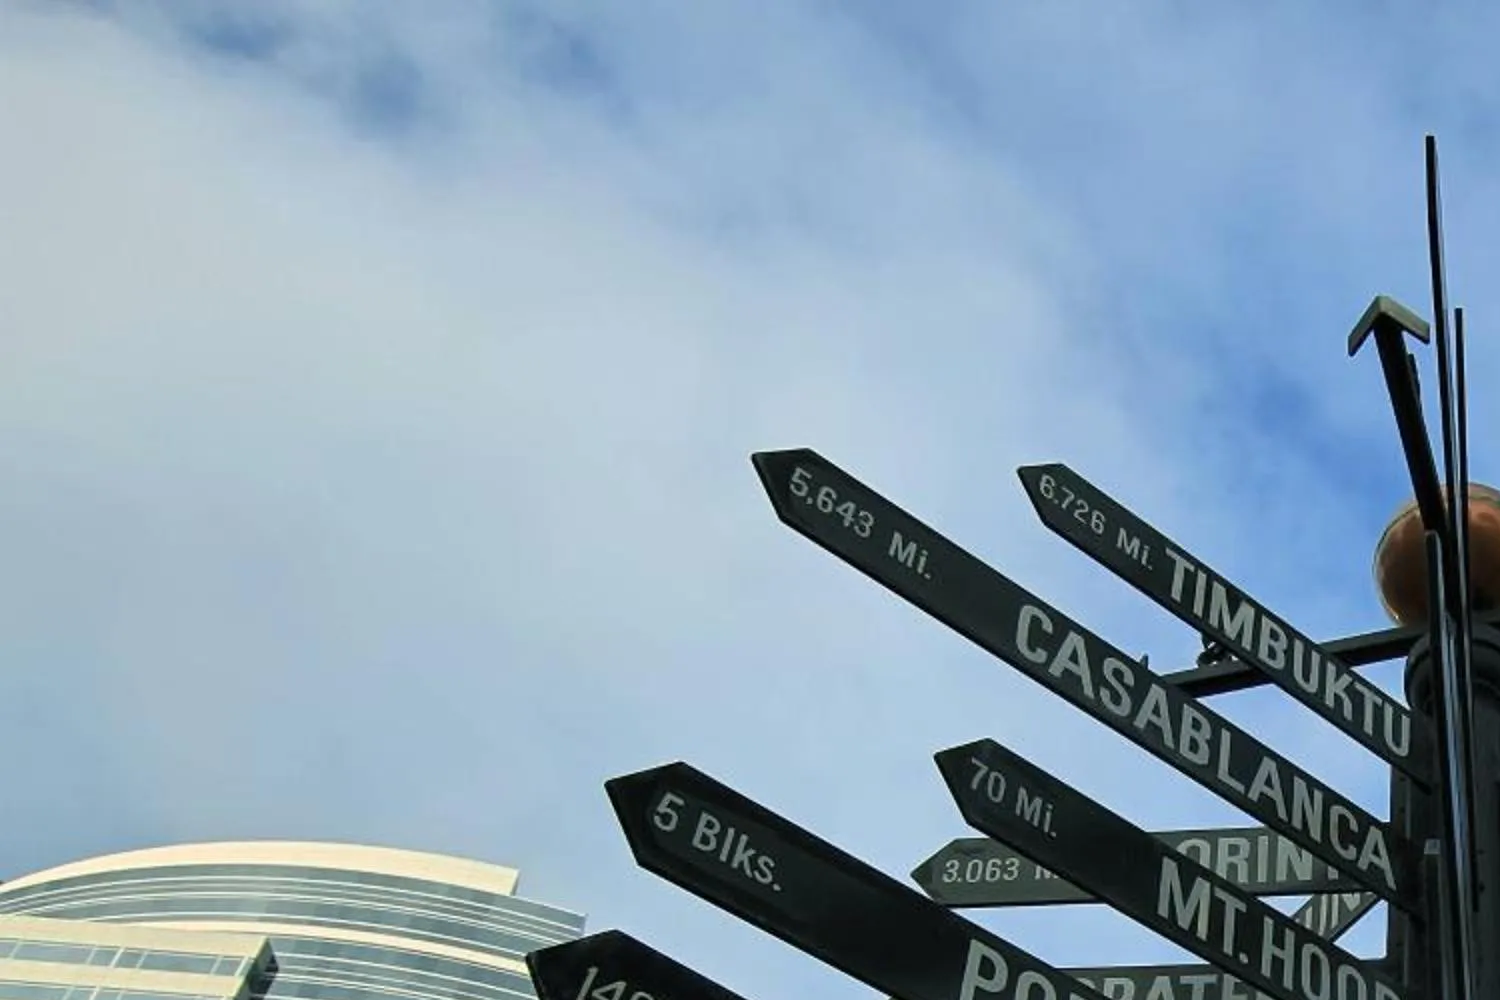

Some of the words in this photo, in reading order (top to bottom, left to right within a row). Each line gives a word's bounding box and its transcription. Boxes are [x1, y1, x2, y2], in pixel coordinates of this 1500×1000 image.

[888, 531, 931, 580] Mi.
[1015, 605, 1396, 891] CASABLANCA
[1116, 527, 1153, 571] Mi.
[1165, 548, 1411, 757] TIMBUKTU
[653, 792, 685, 832] 5
[971, 756, 1006, 803] 70
[1015, 786, 1057, 838] Mi.
[1157, 856, 1249, 965] MT.
